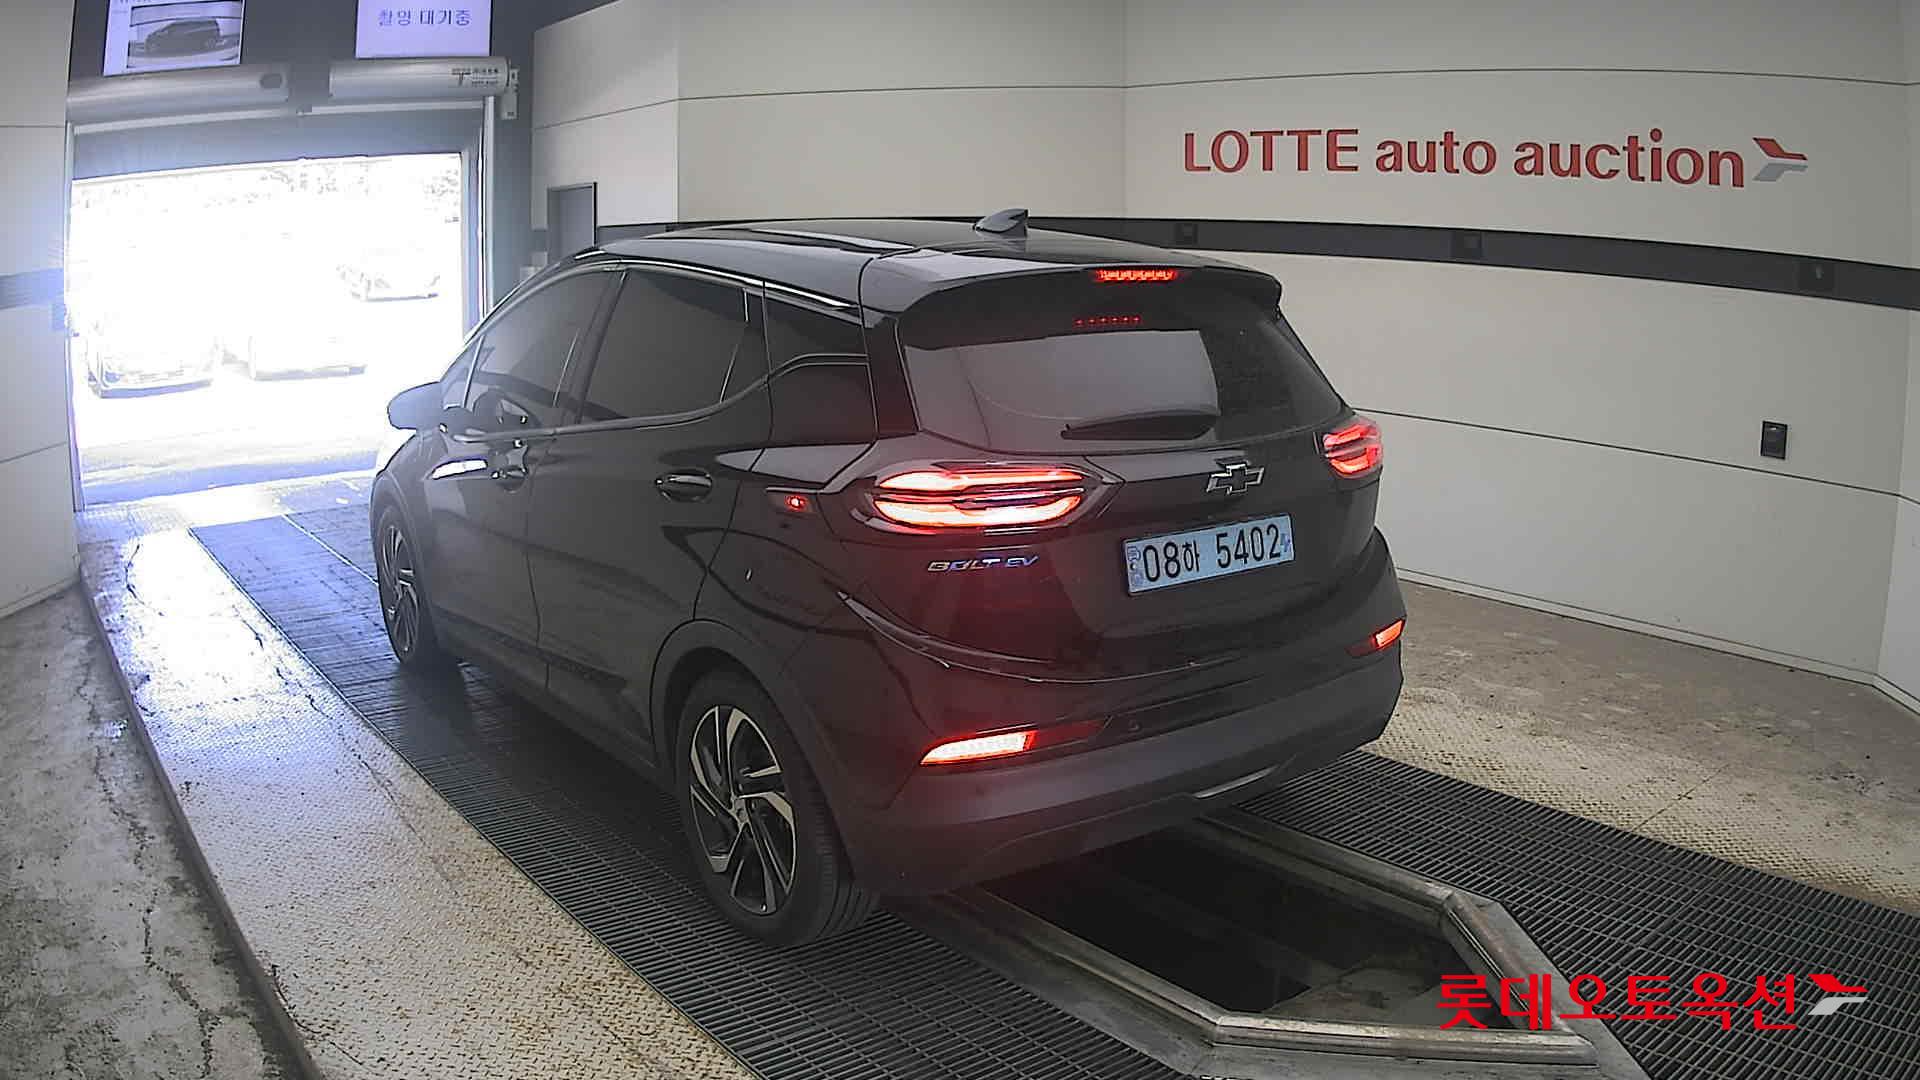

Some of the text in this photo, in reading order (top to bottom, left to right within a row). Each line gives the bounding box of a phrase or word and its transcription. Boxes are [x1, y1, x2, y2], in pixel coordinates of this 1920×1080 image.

[420, 8, 471, 27] 대기중
[1184, 128, 1744, 188] LOTTE auto auction
[927, 556, 1039, 572] BOLT EV
[1142, 523, 1282, 583] 08하 5402
